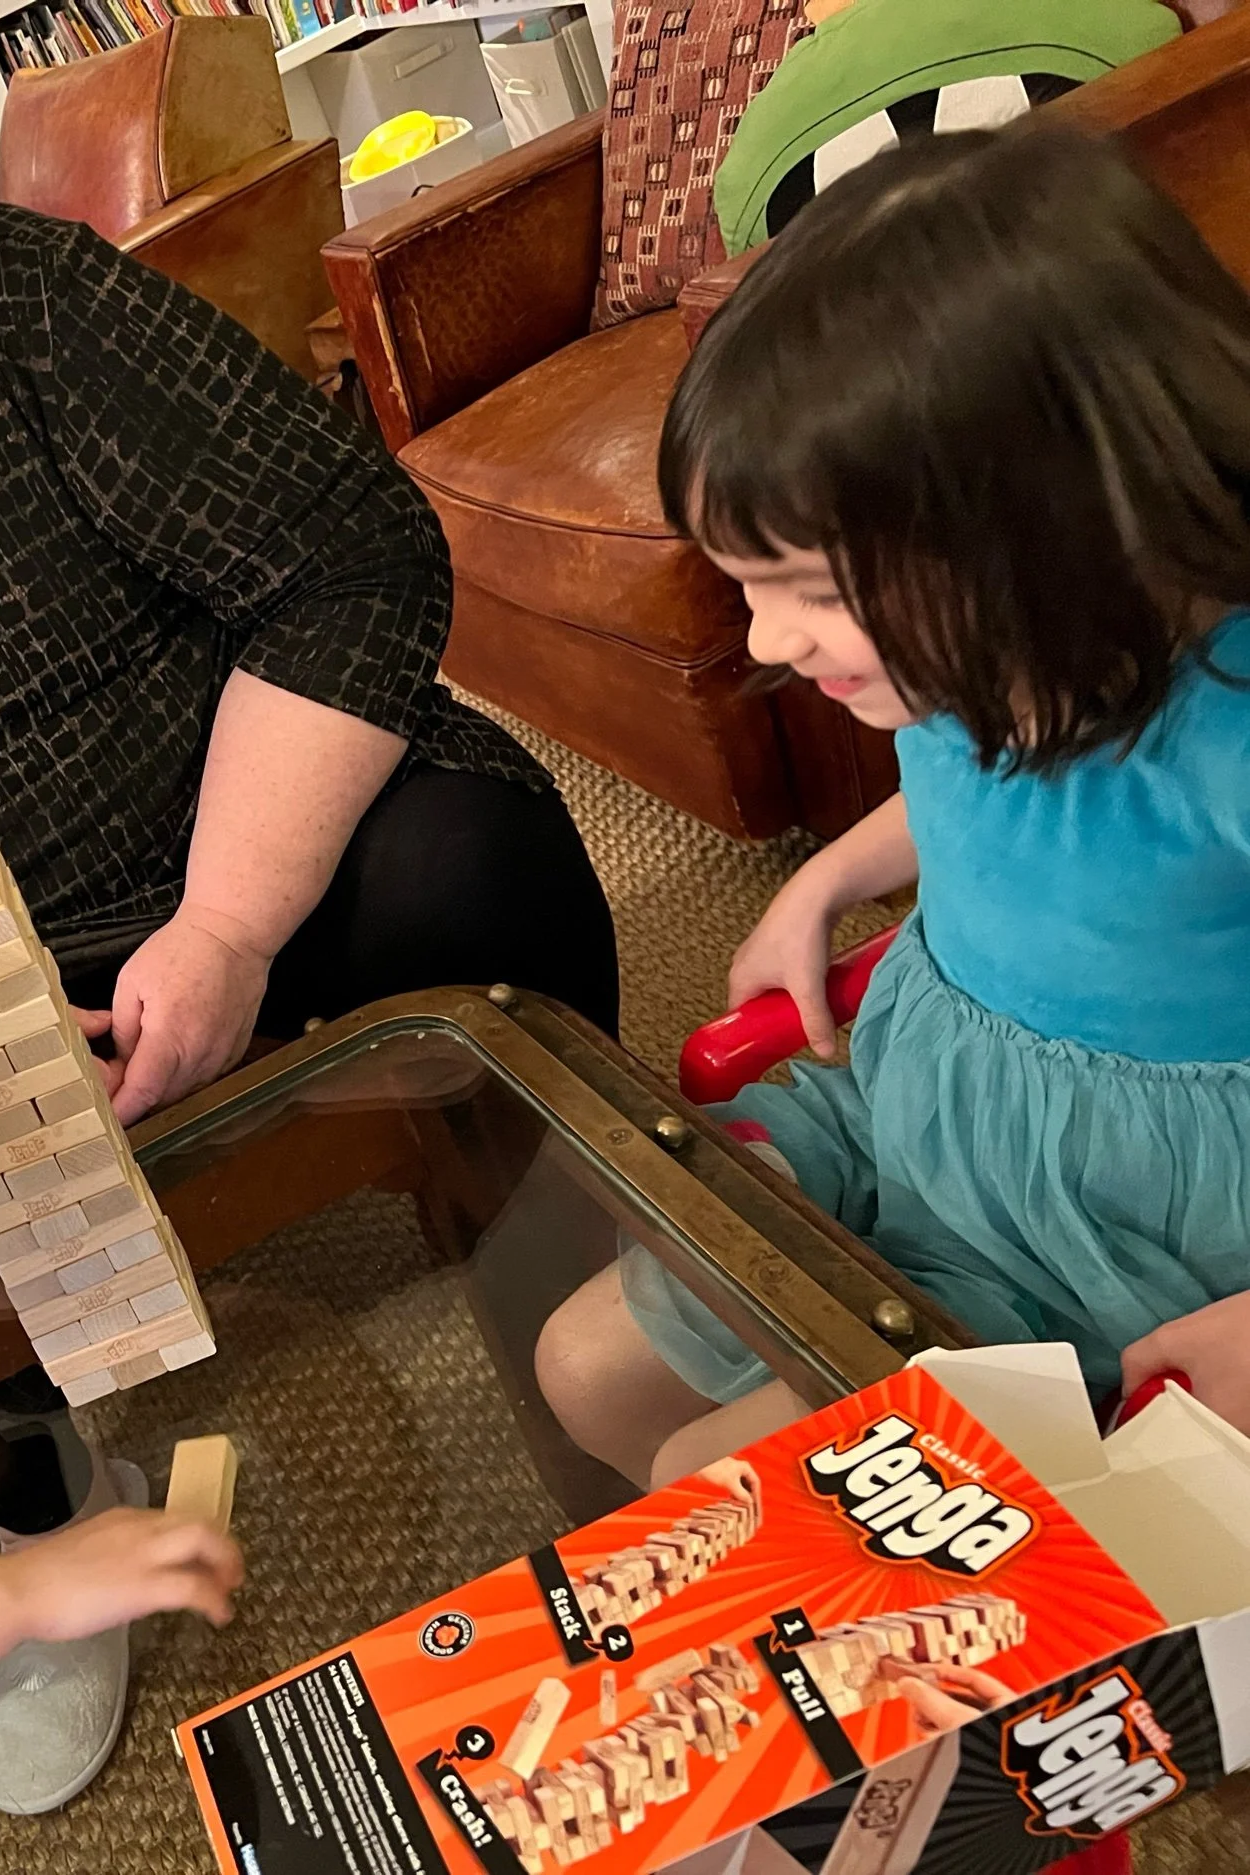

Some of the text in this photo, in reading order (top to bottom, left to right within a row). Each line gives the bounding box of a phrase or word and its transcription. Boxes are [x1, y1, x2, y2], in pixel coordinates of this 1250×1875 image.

[919, 1434, 986, 1480] Classic
[809, 1415, 1032, 1573] Jenga
[550, 1587, 581, 1641] Stack
[783, 1618, 805, 1637] 1
[608, 1634, 628, 1652] 2
[327, 1664, 338, 1676] 54
[337, 1658, 365, 1707] CONTENTS
[331, 1675, 355, 1715] hardwood
[781, 1668, 826, 1723] Pull
[465, 1733, 486, 1752] 3
[1129, 1698, 1174, 1754] Classic
[1013, 1676, 1179, 1833] Jenga
[371, 1773, 397, 1816] stacking
[439, 1774, 494, 1849] Crash!
